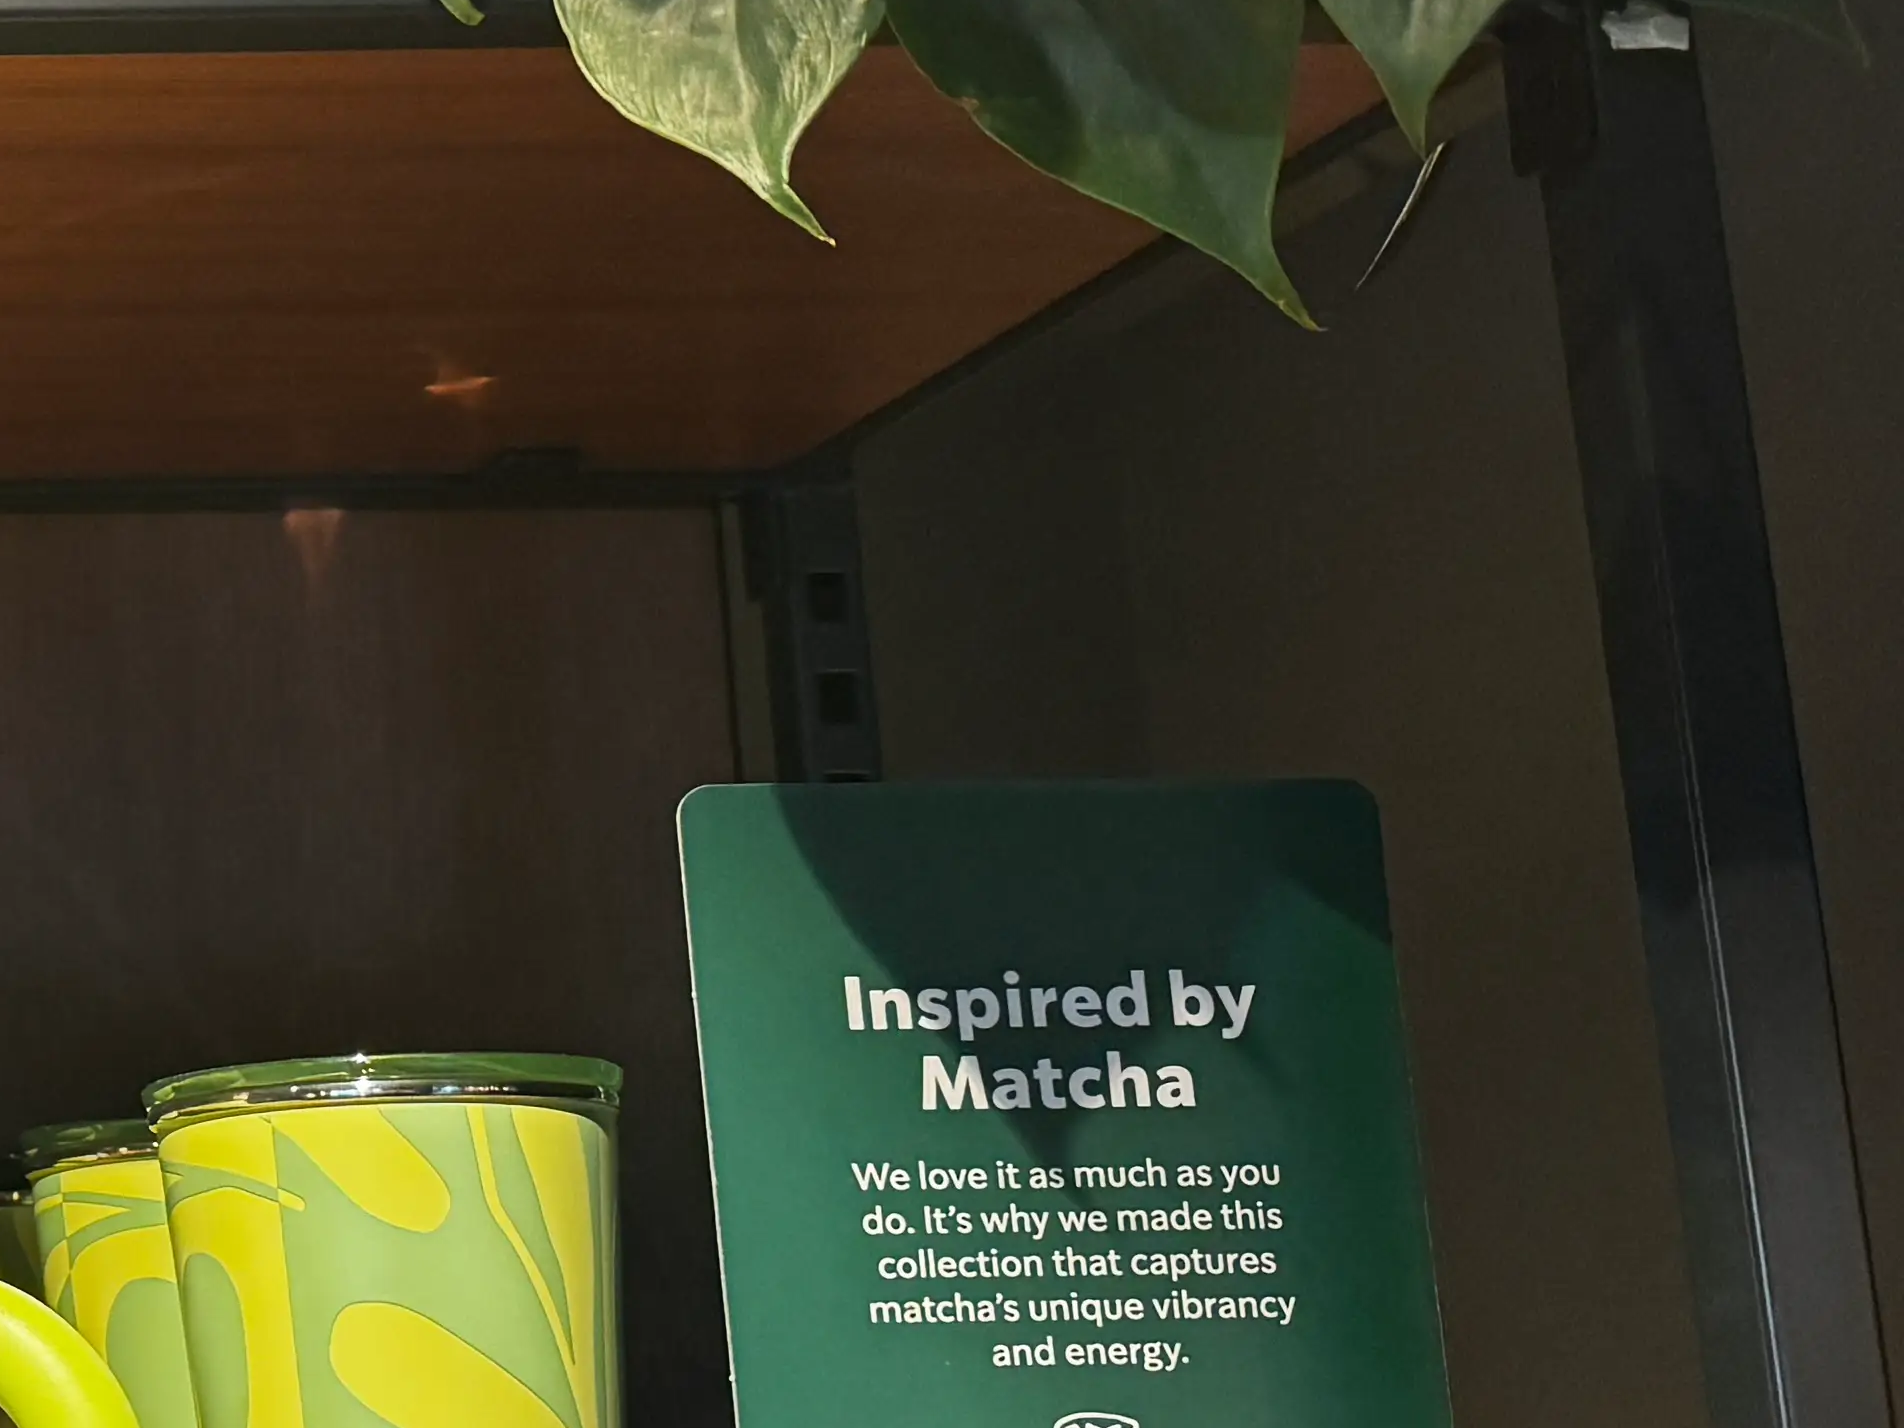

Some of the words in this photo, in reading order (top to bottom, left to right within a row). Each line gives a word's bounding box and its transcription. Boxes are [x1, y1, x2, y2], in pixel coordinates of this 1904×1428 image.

[844, 969, 1150, 1042] Inspired
[1169, 969, 1256, 1039] by
[922, 1051, 1196, 1111] Matcha
[851, 1161, 910, 1192] We
[918, 1160, 988, 1191] love
[996, 1160, 1022, 1189] it
[1028, 1167, 1066, 1190] as
[1074, 1158, 1167, 1189] much
[1176, 1164, 1213, 1189] as
[1222, 1164, 1280, 1193] you
[862, 1205, 916, 1236] do.
[923, 1205, 973, 1235] It's
[981, 1204, 1049, 1240] why
[1058, 1208, 1108, 1233] we
[1117, 1202, 1213, 1232] made
[1220, 1201, 1284, 1231] this
[878, 1249, 1044, 1280] collection
[1051, 1247, 1122, 1277] that
[1130, 1250, 1278, 1281] captures
[869, 1291, 1020, 1324] matcha's
[1028, 1292, 1145, 1328] unique
[1152, 1290, 1297, 1325] vibrancy
[992, 1336, 1056, 1367] and
[1065, 1340, 1190, 1371] energy.
